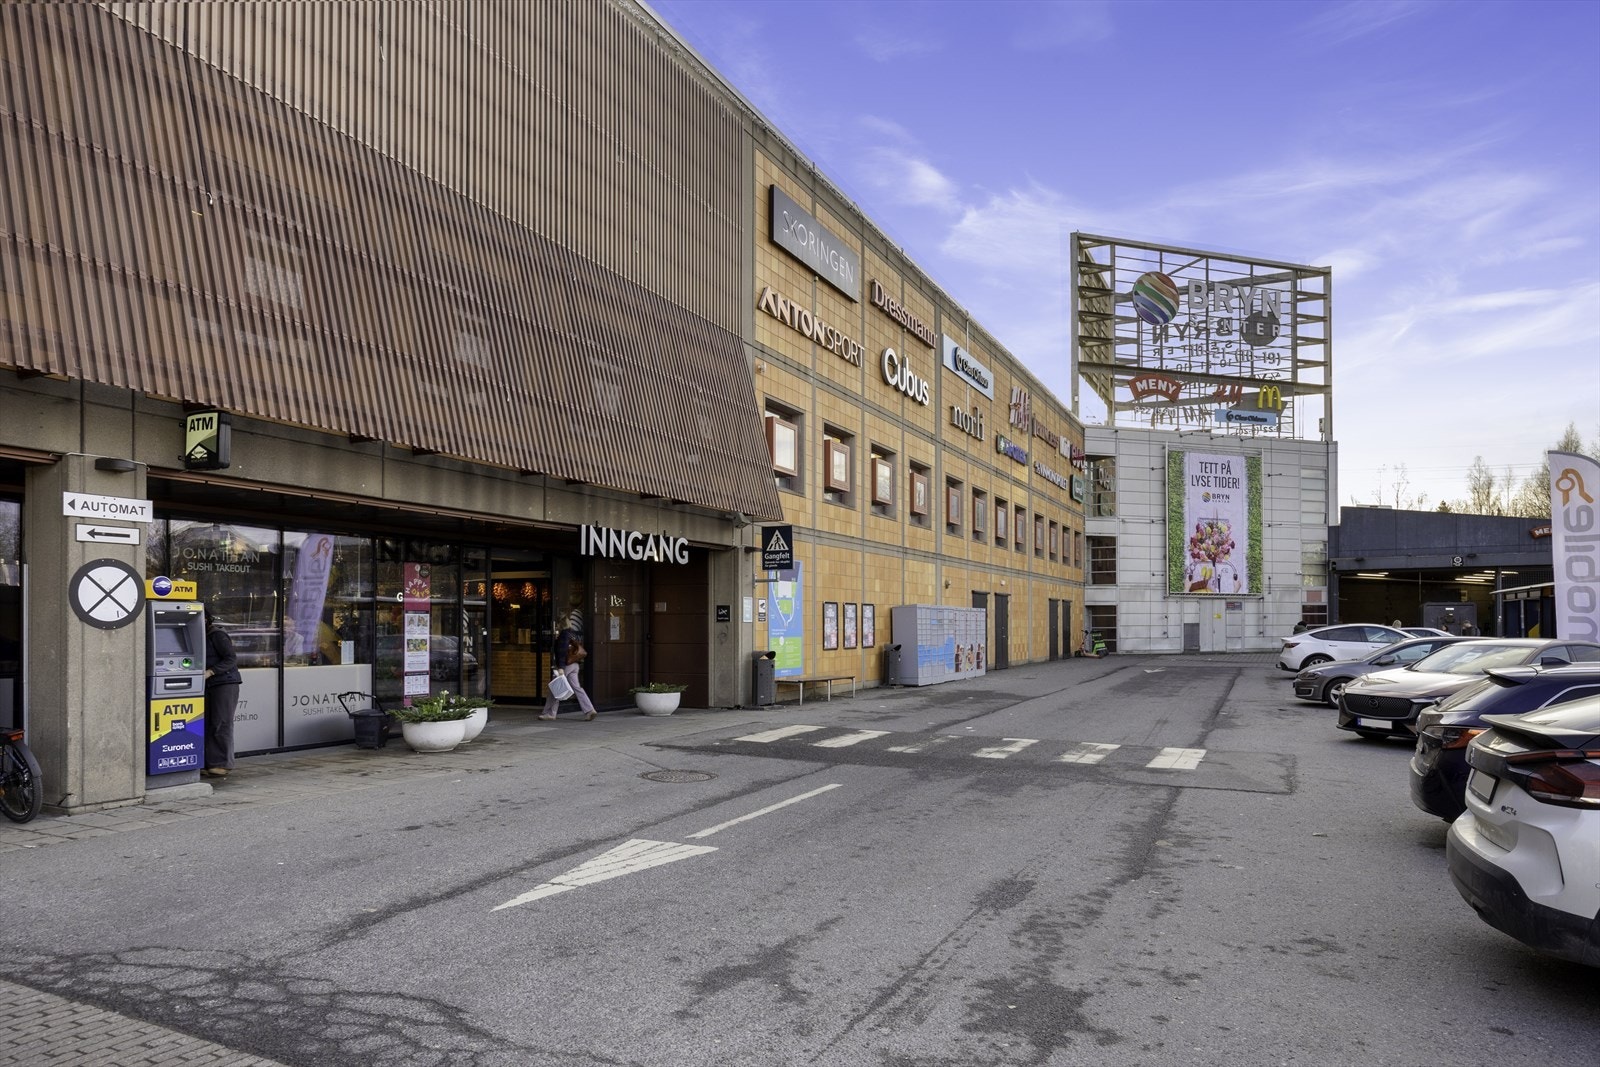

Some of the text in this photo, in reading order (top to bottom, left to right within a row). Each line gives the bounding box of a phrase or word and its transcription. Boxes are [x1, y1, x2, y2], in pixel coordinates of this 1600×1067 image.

[782, 210, 854, 284] SKORINGEN
[1188, 280, 1281, 319] BRYN
[871, 278, 937, 349] Dressmann
[1189, 315, 1281, 337] SENTER
[881, 348, 930, 406] Cubus
[1135, 378, 1177, 395] MENY
[189, 416, 213, 433] ATM
[950, 405, 985, 442] norli
[1199, 460, 1232, 475] TETT PÅ
[1191, 475, 1240, 489] LYSE TIDER!
[80, 500, 147, 517] AUTOMAT
[1535, 527, 1552, 536] ME
[581, 524, 689, 565] INNGANG
[171, 547, 260, 563] JONATHAN
[764, 552, 790, 561] Gangfelt
[187, 561, 251, 573] SUSHI TAKEOUT
[405, 578, 427, 594] HAPPY
[411, 588, 430, 598] DAYS
[292, 691, 366, 707] JONATHAN
[163, 703, 194, 716] ATM
[303, 705, 357, 716] SUSHI TAKEOUT
[162, 742, 194, 752] Euronet
